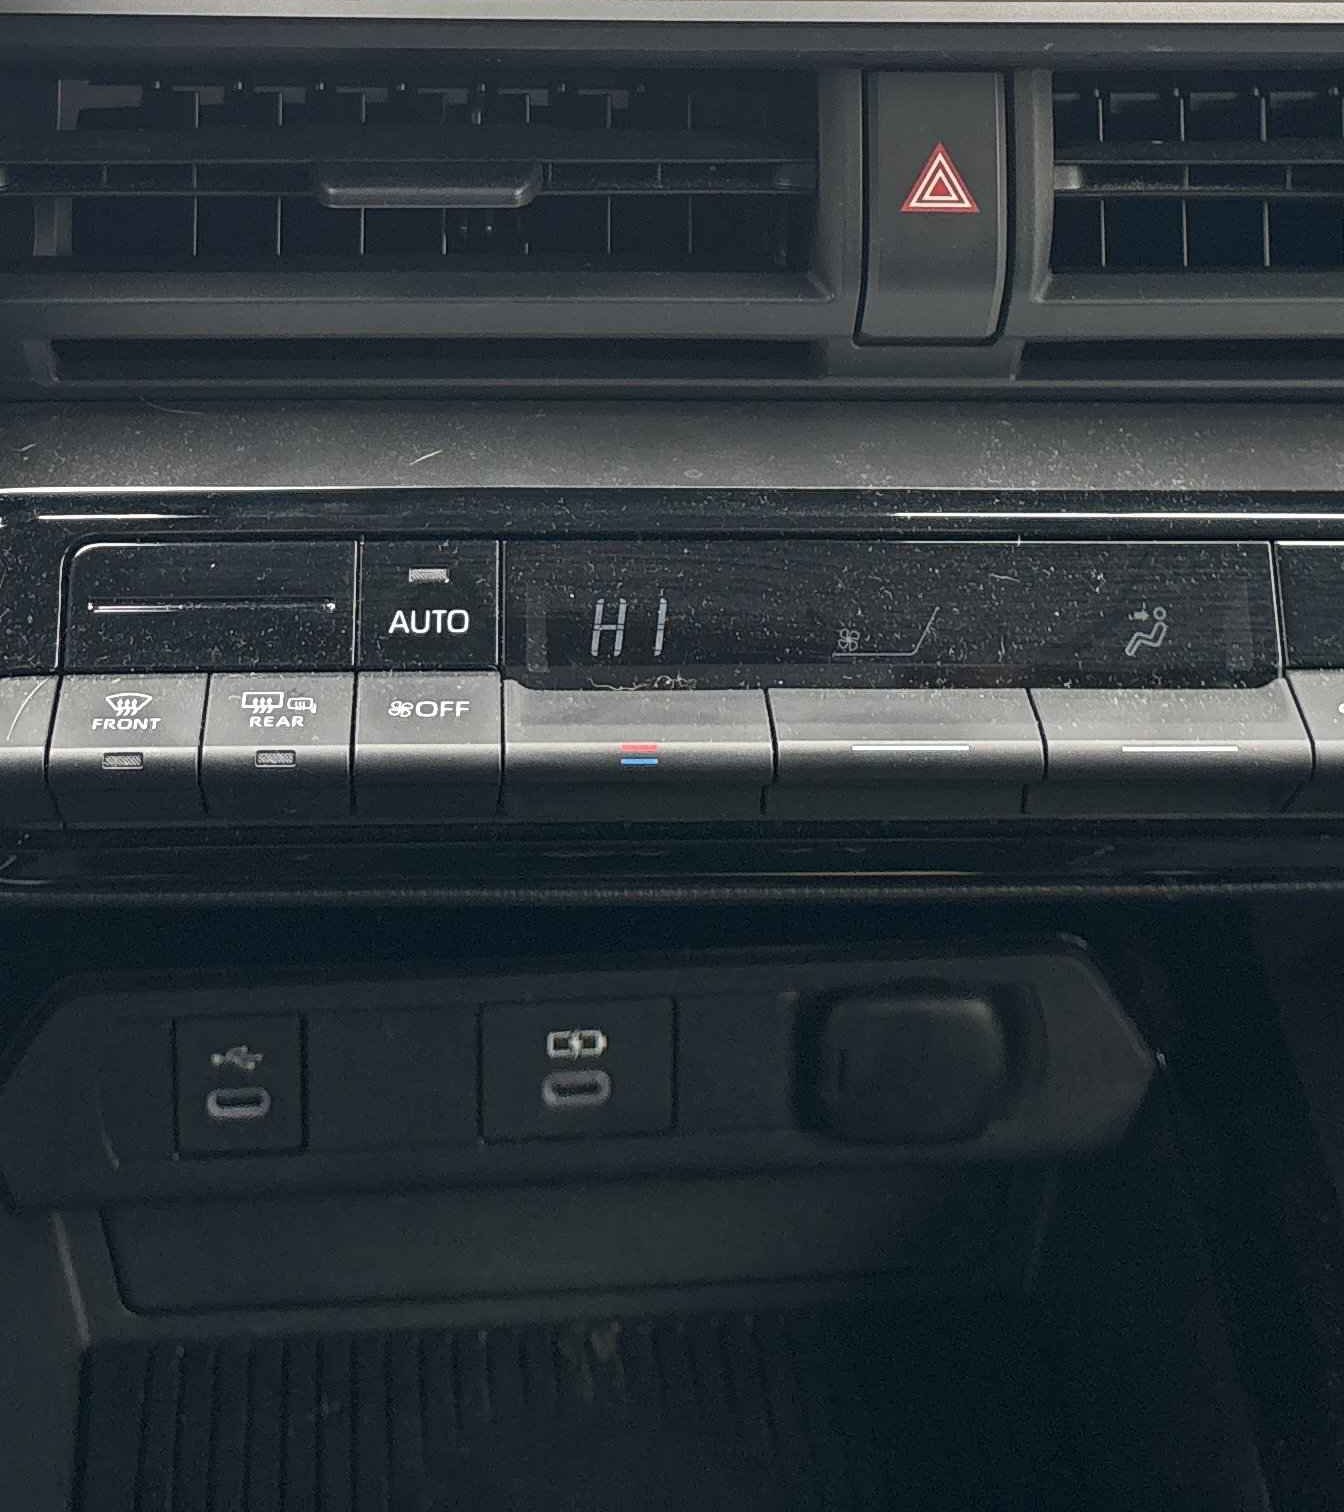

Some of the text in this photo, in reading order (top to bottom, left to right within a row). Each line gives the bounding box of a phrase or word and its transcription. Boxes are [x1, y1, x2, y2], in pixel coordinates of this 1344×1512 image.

[388, 608, 470, 636] AUTO
[415, 700, 471, 719] OFF
[91, 717, 162, 731] FRONT
[248, 715, 305, 728] REAR
